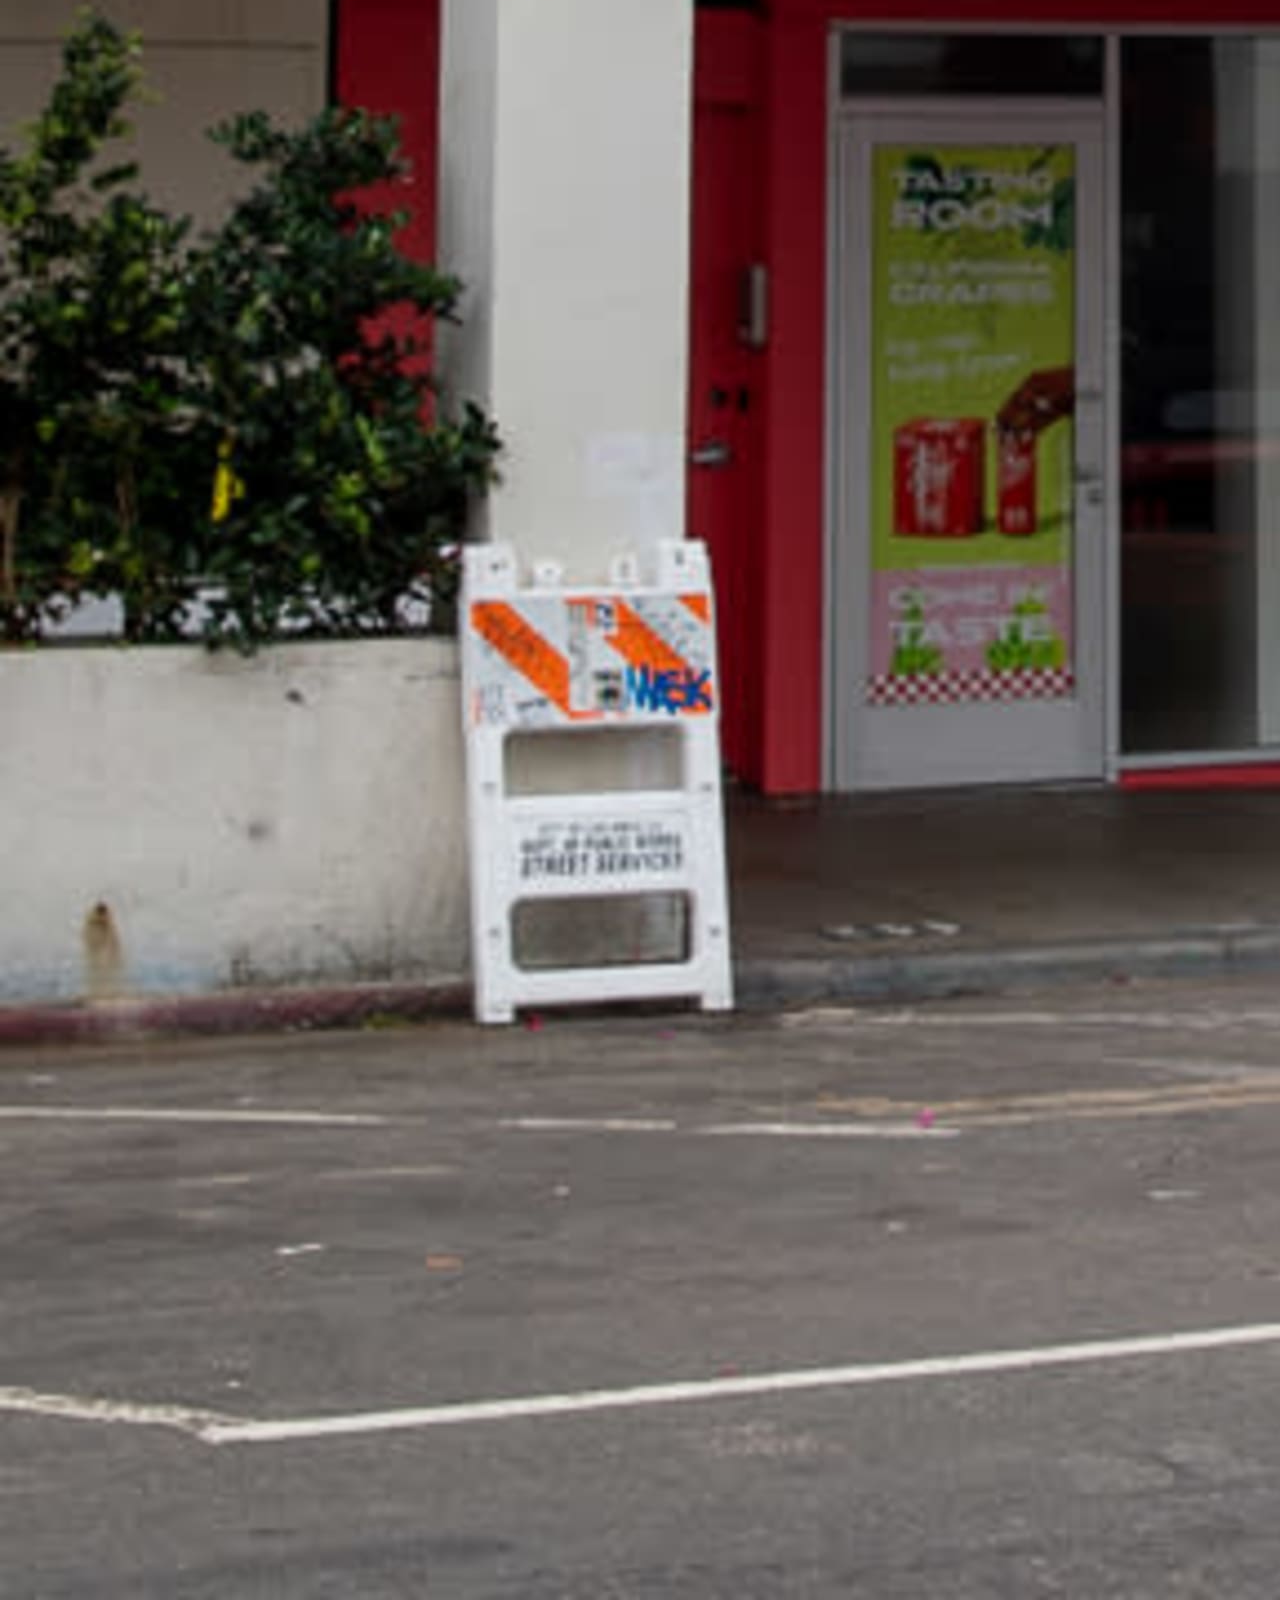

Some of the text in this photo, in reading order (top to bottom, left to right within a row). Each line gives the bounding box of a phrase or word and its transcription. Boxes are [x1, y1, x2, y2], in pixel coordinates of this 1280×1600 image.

[890, 167, 1056, 194] TASTING
[890, 197, 1055, 230] ROOM
[888, 614, 1054, 647] TASTE
